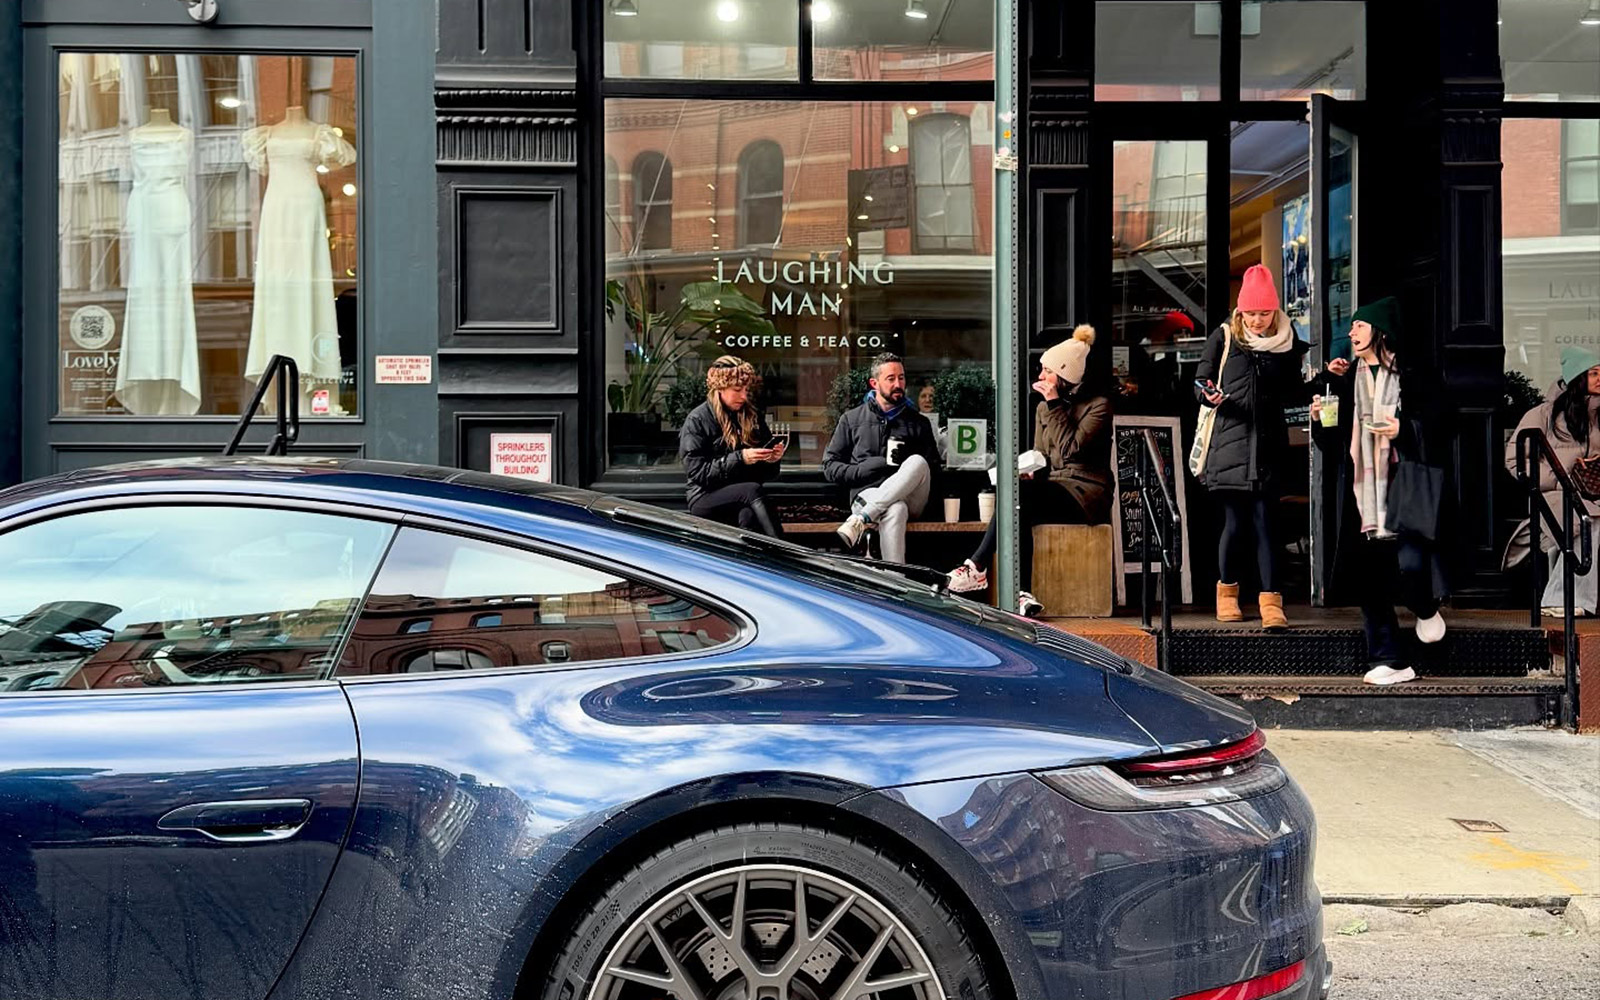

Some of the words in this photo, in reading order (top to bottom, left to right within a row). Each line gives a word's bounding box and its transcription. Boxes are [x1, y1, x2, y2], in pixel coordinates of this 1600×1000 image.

[717, 260, 895, 285] LAUGHING
[771, 292, 841, 316] MAN
[724, 335, 792, 347] COFFEE
[799, 335, 810, 347] &
[817, 336, 850, 347] TEA
[857, 335, 886, 347] CO.
[63, 350, 119, 374] Lovely
[497, 442, 546, 452] SPRINKLERS
[957, 425, 977, 454] B
[495, 453, 548, 463] THROUGHOUT
[503, 465, 540, 475] BUILDING
